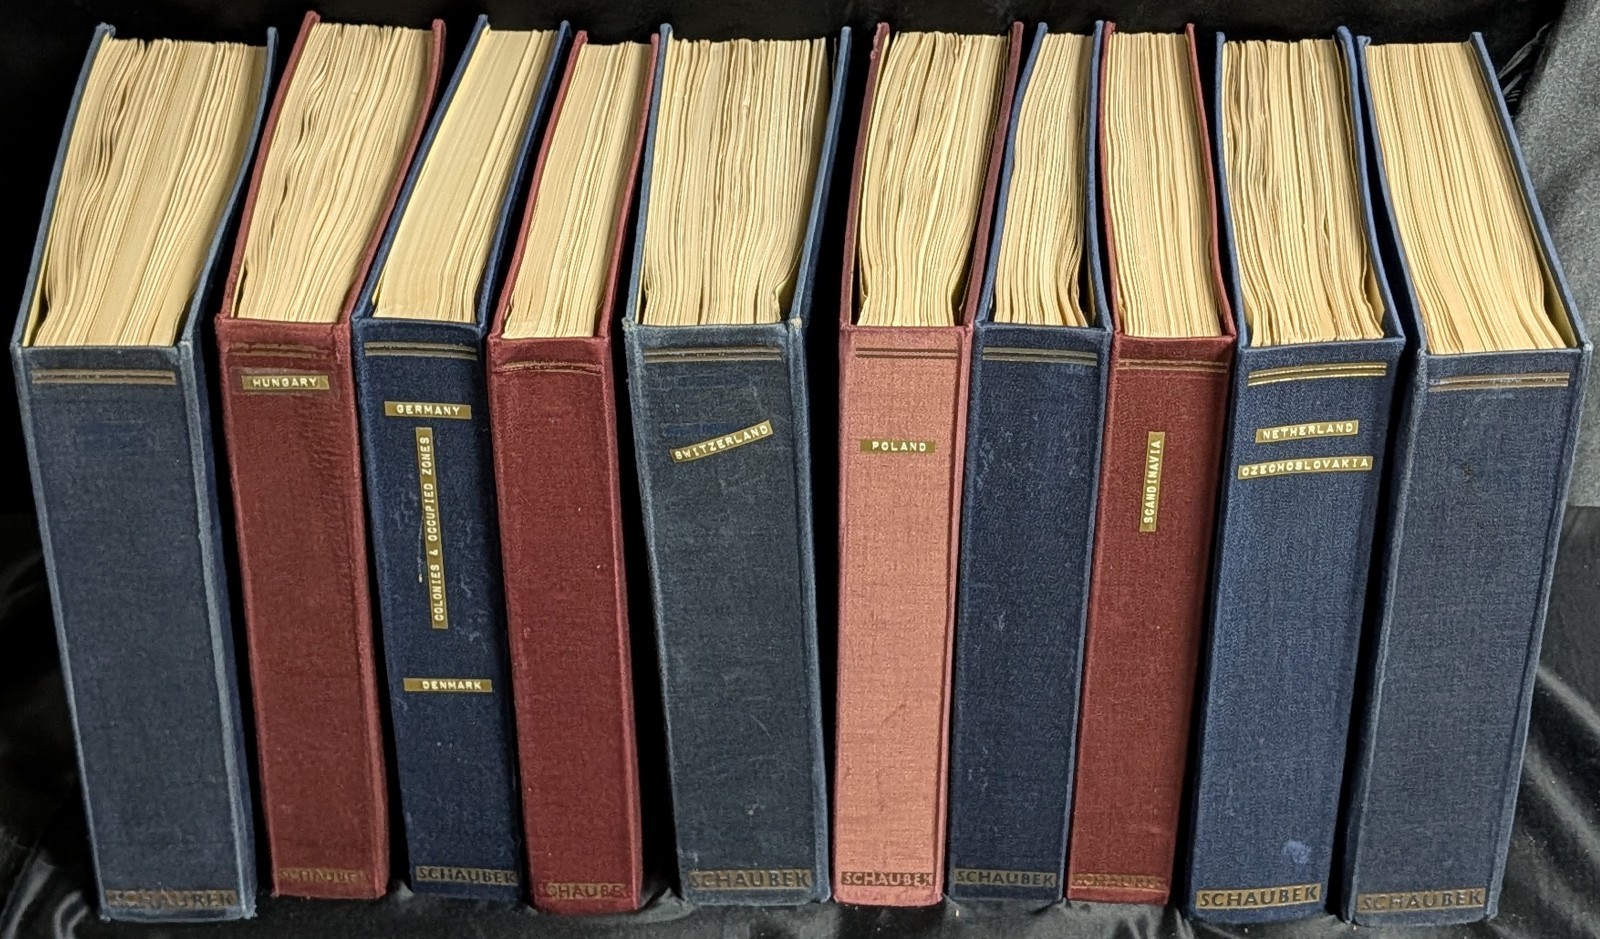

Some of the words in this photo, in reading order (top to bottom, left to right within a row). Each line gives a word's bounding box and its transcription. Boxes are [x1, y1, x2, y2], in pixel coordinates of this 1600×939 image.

[252, 377, 318, 388] HUNGARY
[396, 403, 461, 416] GERMANY
[1262, 422, 1354, 440] NETHERLAND
[674, 424, 769, 460] SWITZERLAND
[871, 441, 927, 452] POLAND
[420, 437, 432, 476] ZONES
[1241, 457, 1369, 477] CZECHOSLOVAKIA
[1143, 440, 1162, 524] SCANDINAVIA
[423, 483, 438, 542] OCCUPIED
[430, 564, 444, 621] COLONIES
[422, 680, 482, 690] DENMARK
[418, 867, 517, 884] SCHAUBEK
[689, 869, 810, 888] SCHAUBEK
[844, 872, 935, 886] SCHAUBEK
[957, 870, 1054, 887] SCHAUBEK
[1199, 885, 1318, 907] SCHAUBEK
[1361, 889, 1482, 911] SCHAUBEK
